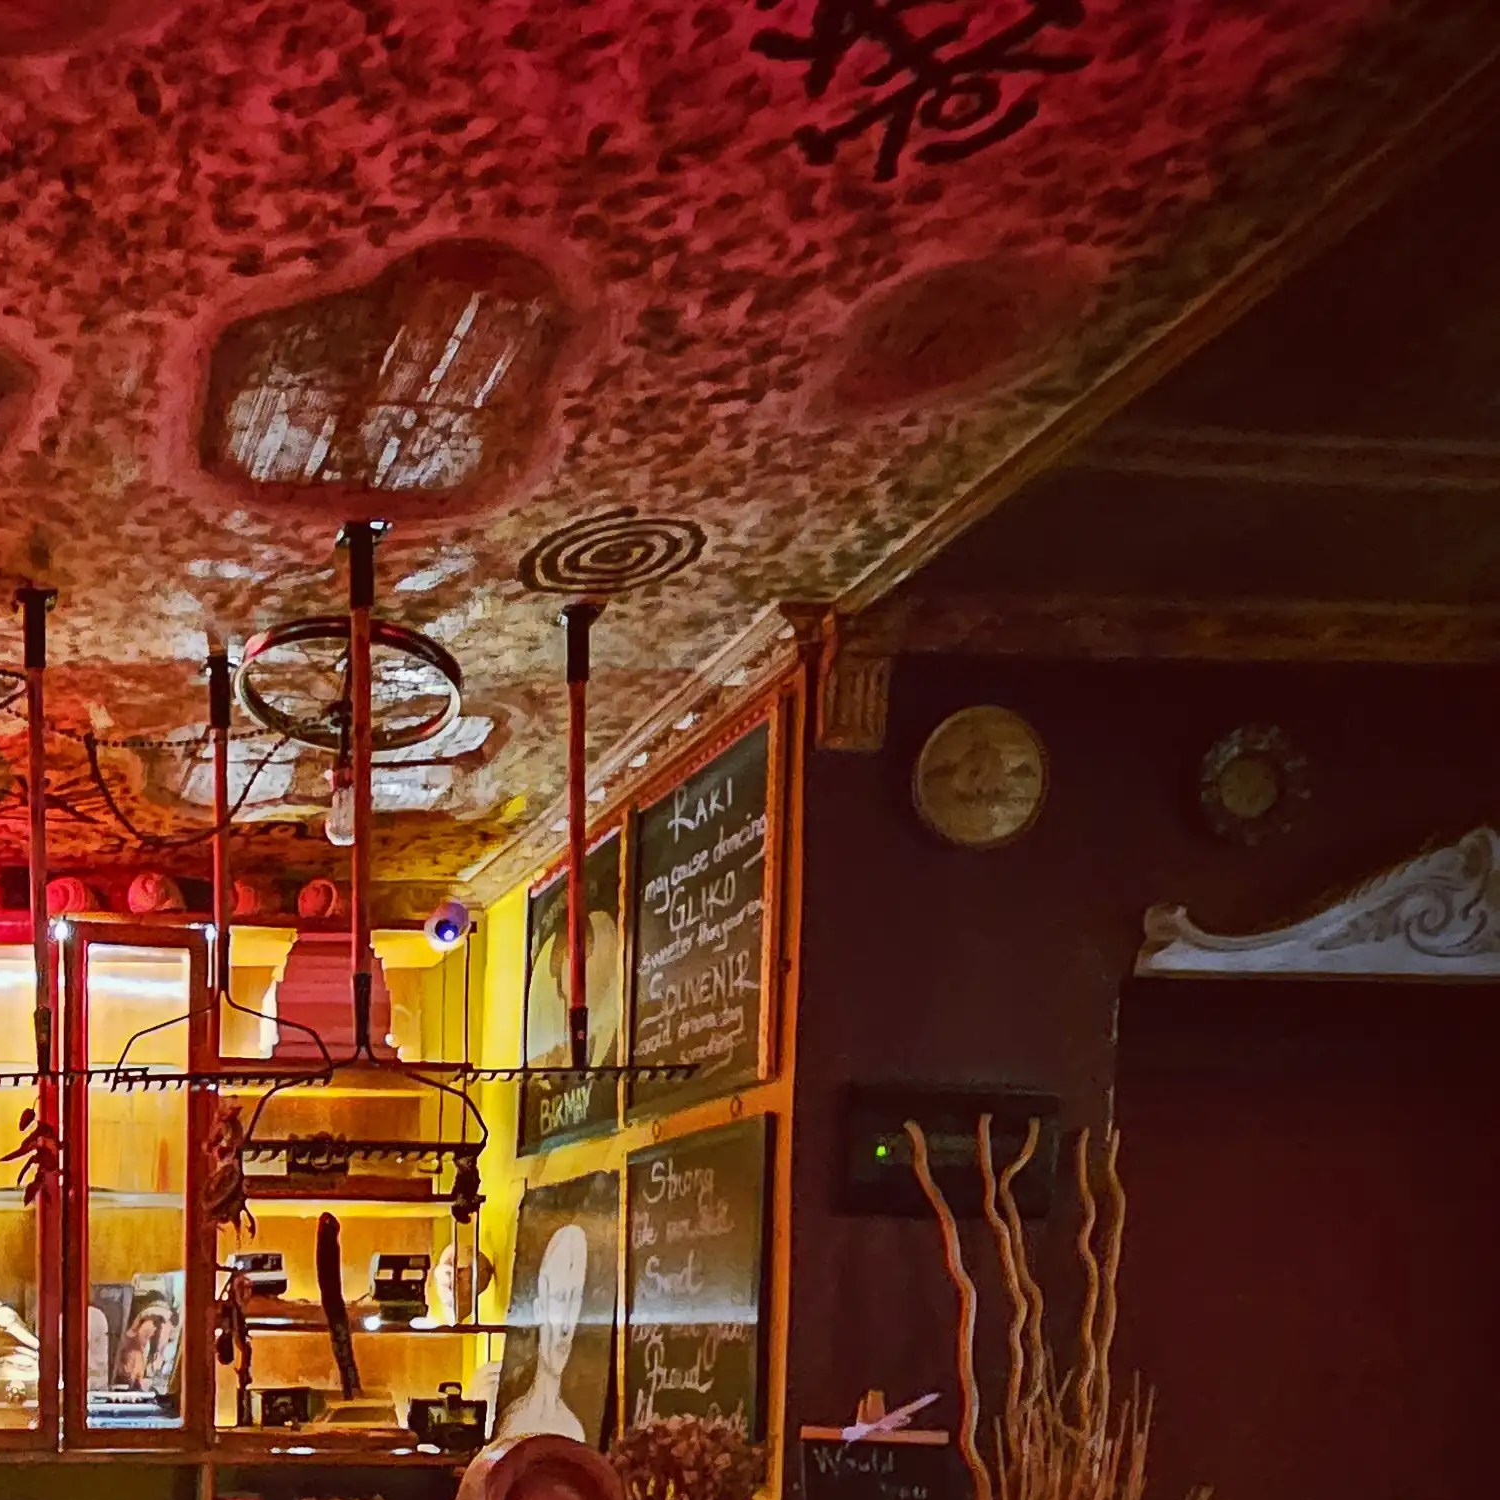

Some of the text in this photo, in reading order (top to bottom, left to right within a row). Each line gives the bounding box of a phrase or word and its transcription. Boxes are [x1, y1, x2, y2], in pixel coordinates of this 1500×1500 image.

[667, 777, 733, 843] RAKI
[669, 870, 736, 933] GLIKO
[639, 950, 760, 1029] SOUVENIR
[642, 1157, 715, 1210] Strong
[812, 1442, 895, 1478] Would
